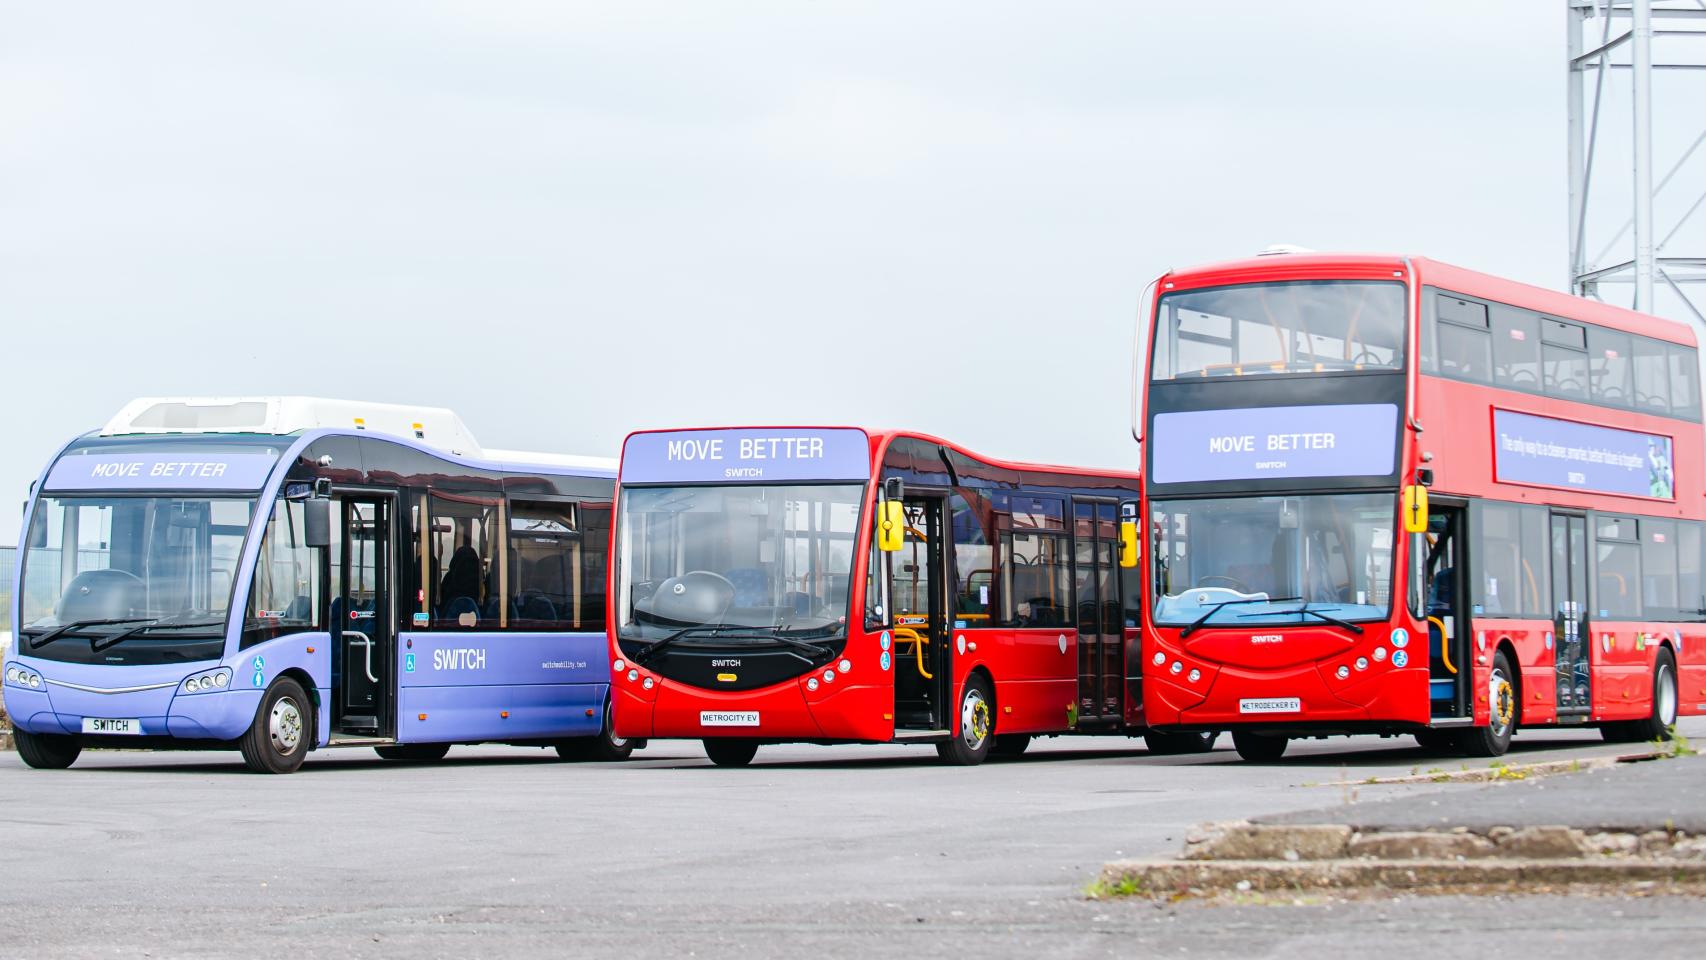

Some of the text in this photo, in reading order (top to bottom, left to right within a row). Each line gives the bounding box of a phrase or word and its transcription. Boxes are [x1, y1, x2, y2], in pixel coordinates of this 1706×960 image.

[1210, 433, 1335, 453] MOVE BETTER
[668, 437, 824, 461] MOVE BETTER
[91, 462, 227, 477] MOVE BETTER
[1255, 461, 1287, 469] SWITCH
[724, 468, 763, 477] SWITCH
[1251, 634, 1284, 643] SWITCH
[433, 648, 486, 670] SWITCH
[711, 659, 741, 667] SWITCH
[542, 660, 587, 669] switchmobility.tech
[1241, 701, 1299, 710] METRODECKER EV
[702, 714, 757, 722] METROCITY EV
[93, 719, 129, 731] SWITCH
